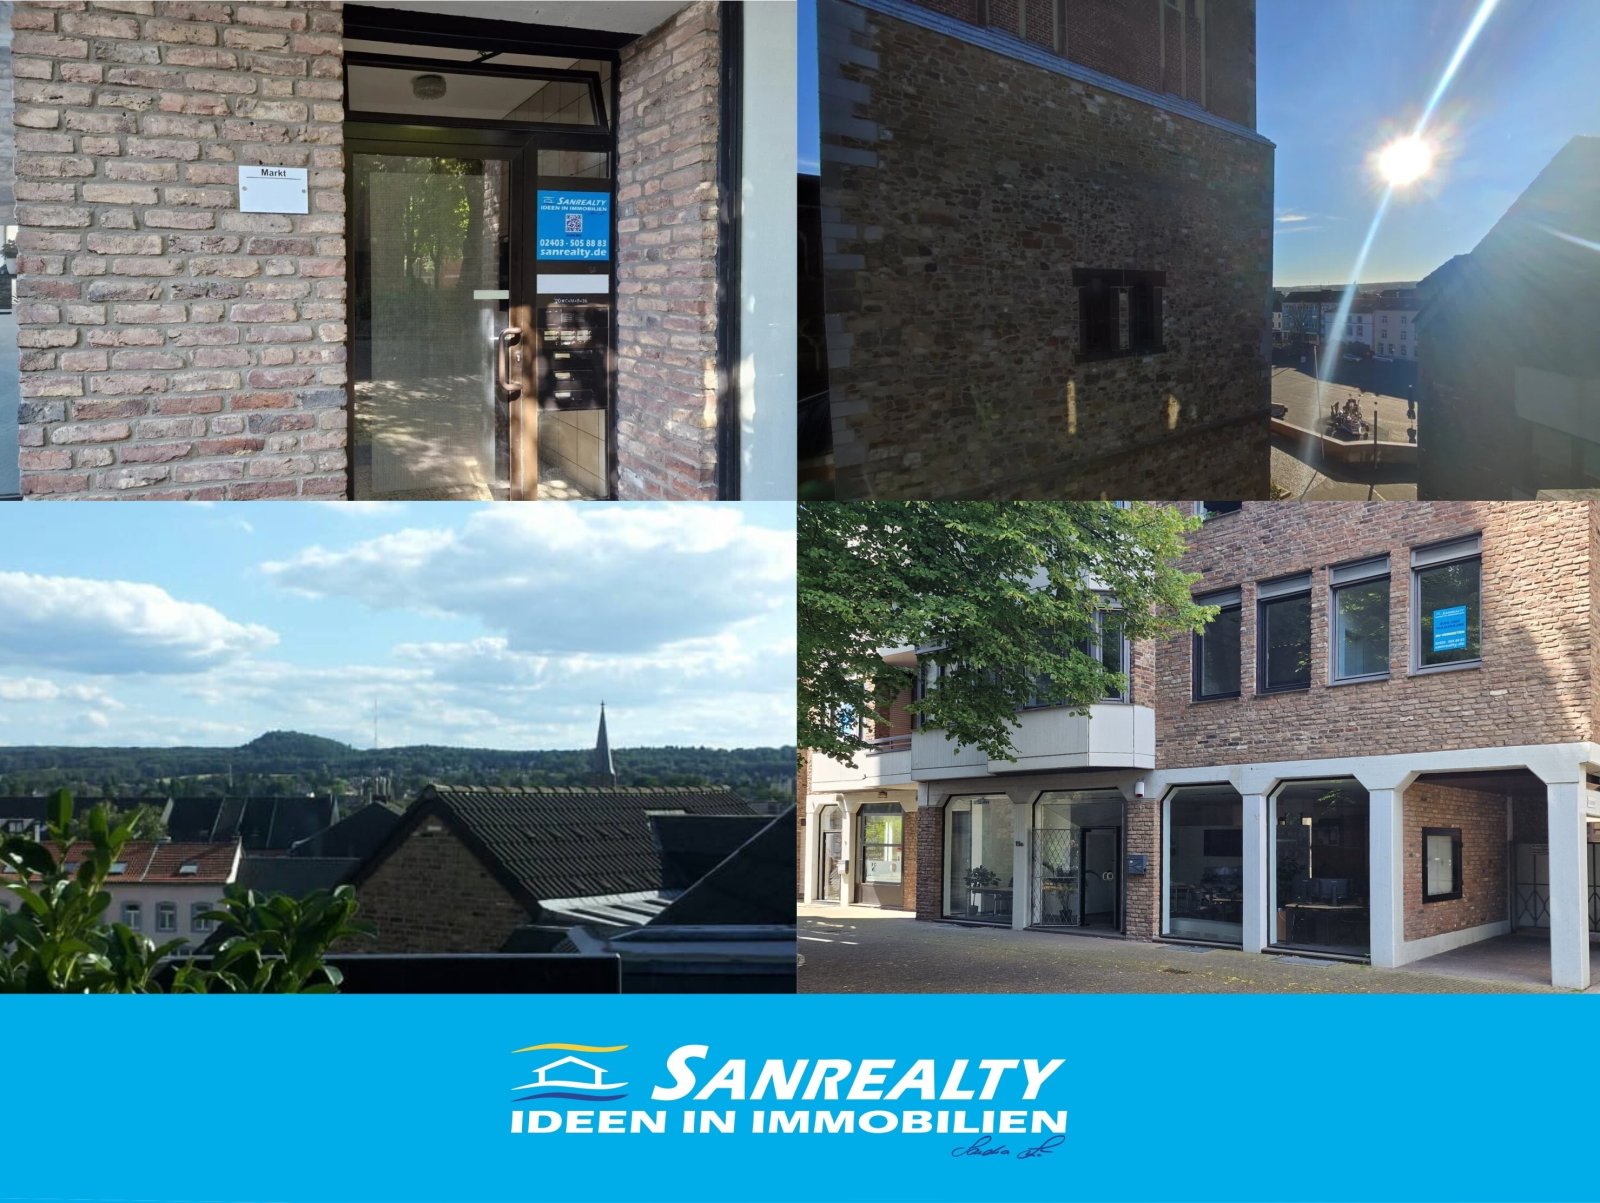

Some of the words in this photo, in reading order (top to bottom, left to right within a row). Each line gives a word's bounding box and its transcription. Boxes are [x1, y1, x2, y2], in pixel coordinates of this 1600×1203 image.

[261, 168, 287, 177] Markt
[556, 197, 607, 206] SANREALTY
[540, 239, 564, 247] 02403
[570, 239, 584, 247] 505
[540, 248, 607, 258] sanrealty.de
